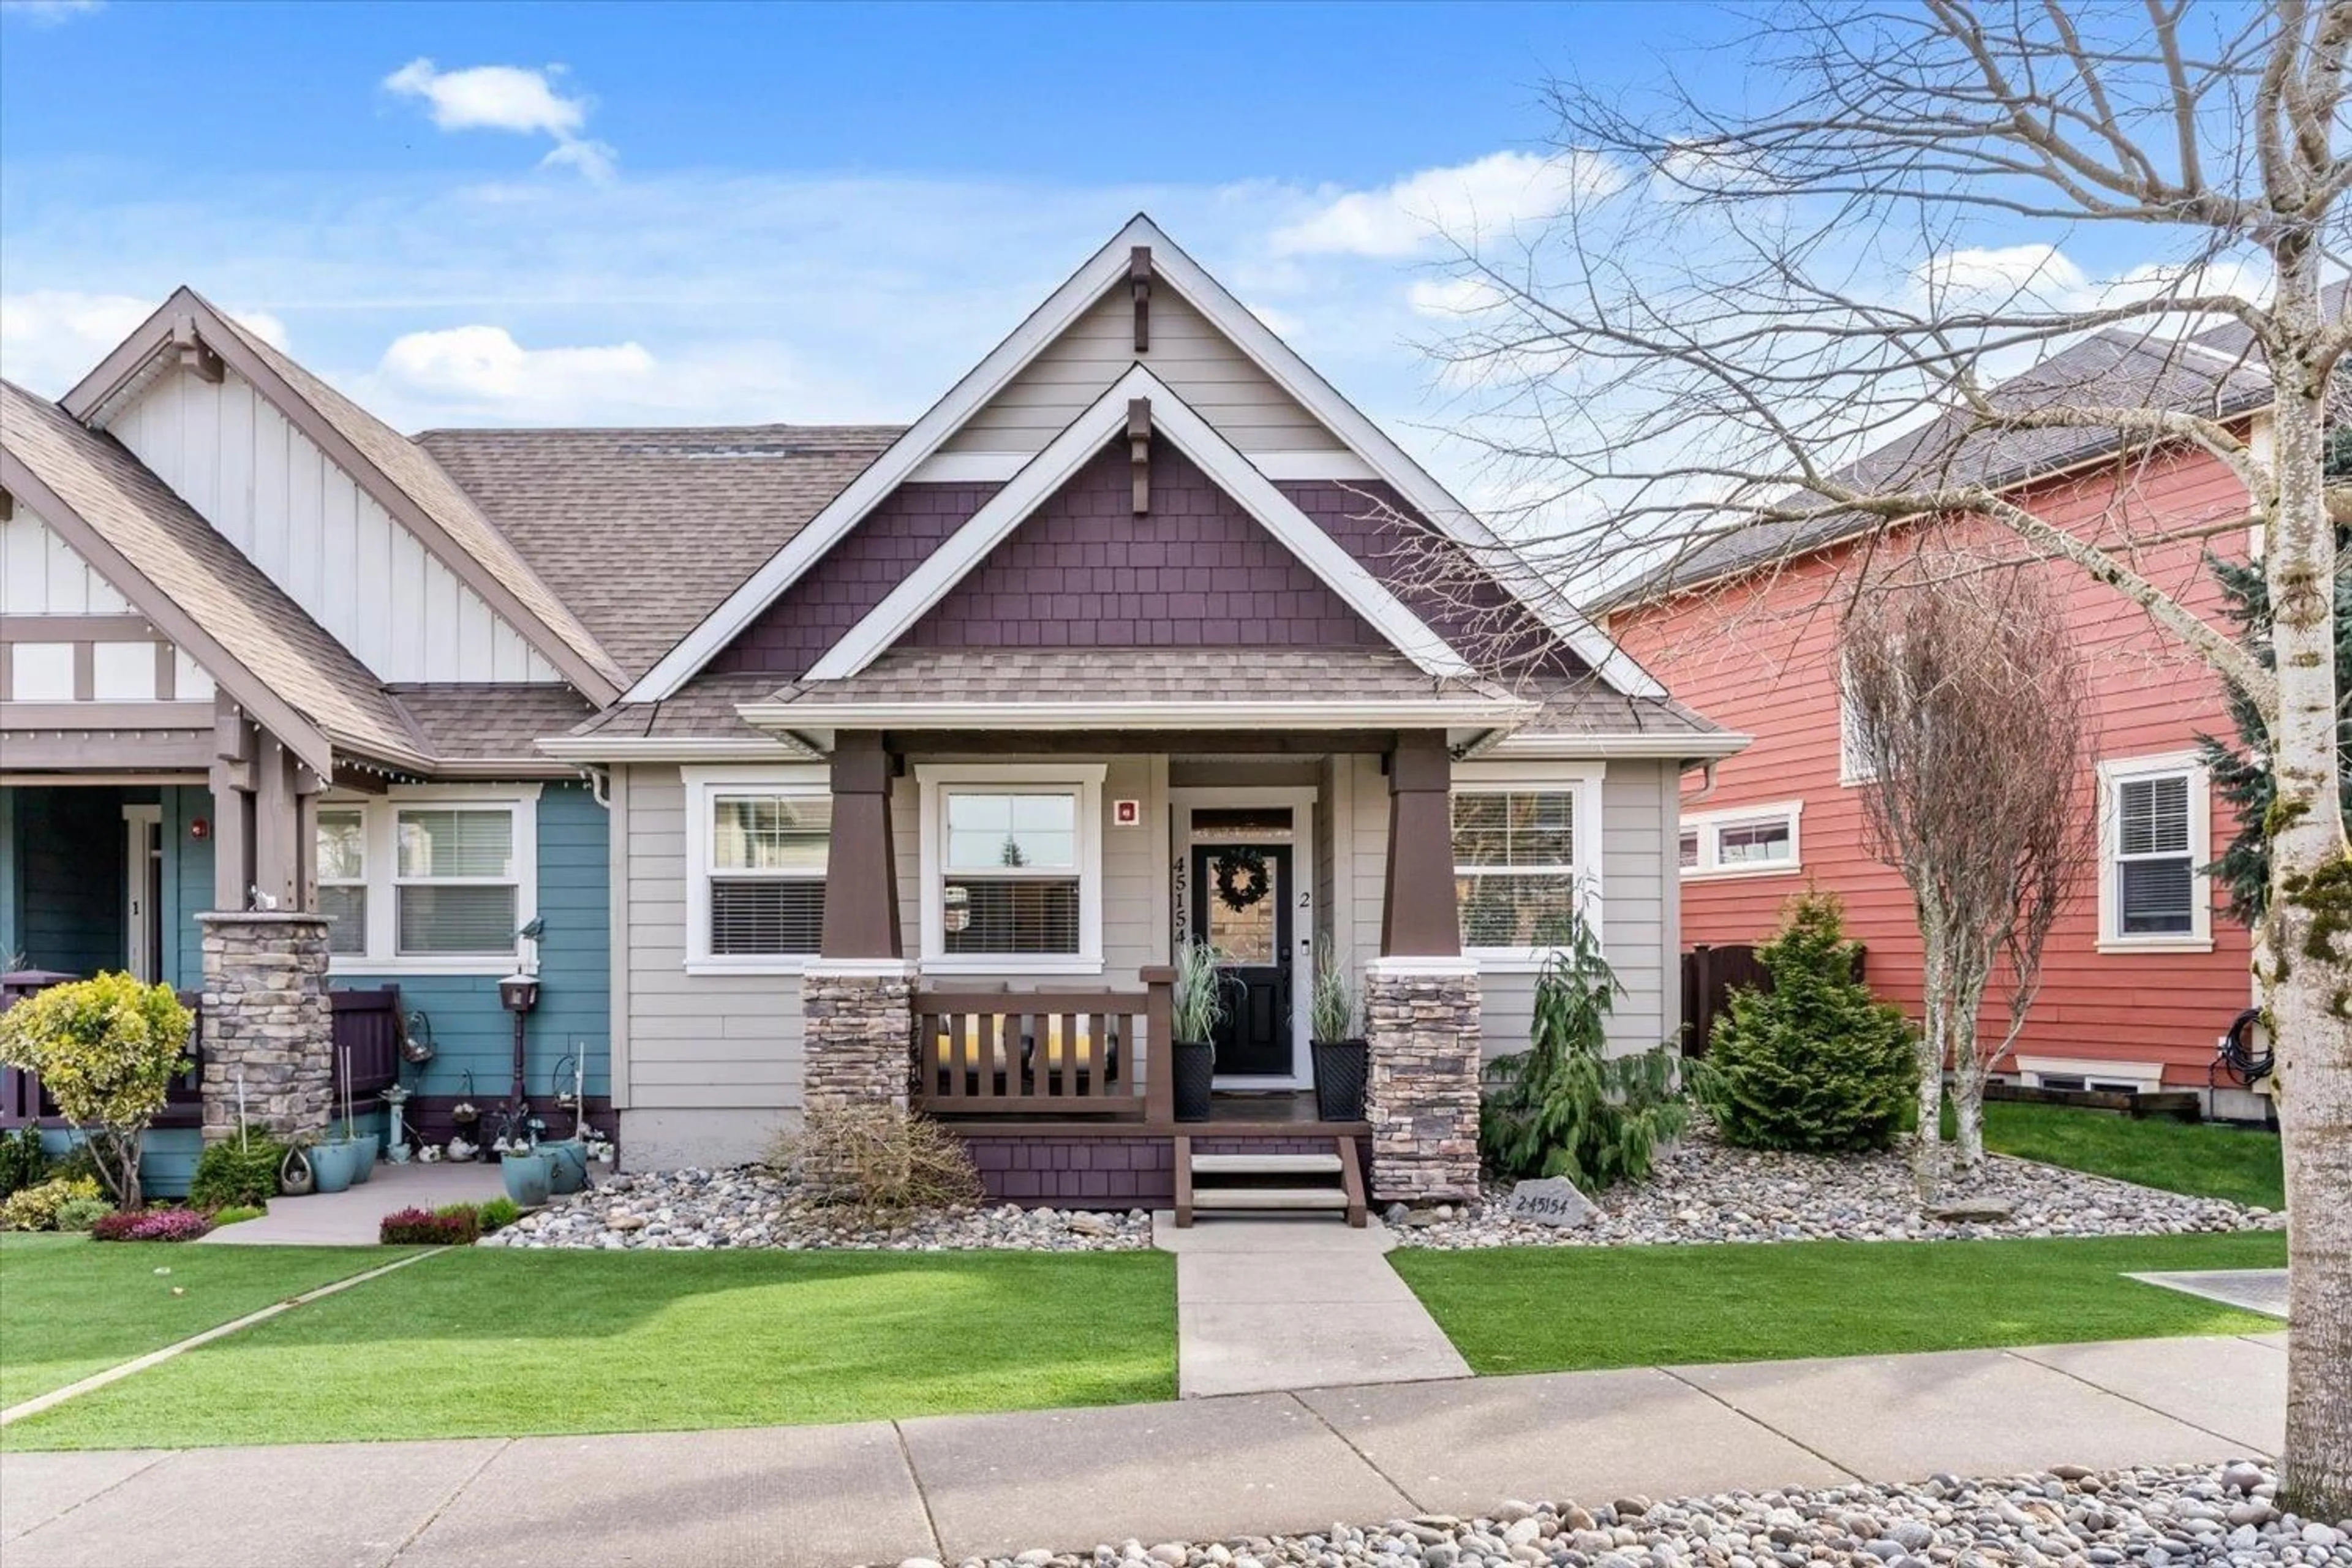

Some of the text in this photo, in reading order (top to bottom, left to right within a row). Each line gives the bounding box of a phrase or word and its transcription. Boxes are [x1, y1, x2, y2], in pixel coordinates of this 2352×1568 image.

[1172, 856, 1186, 944] 45154
[1300, 892, 1310, 907] 2
[133, 901, 138, 915] 1
